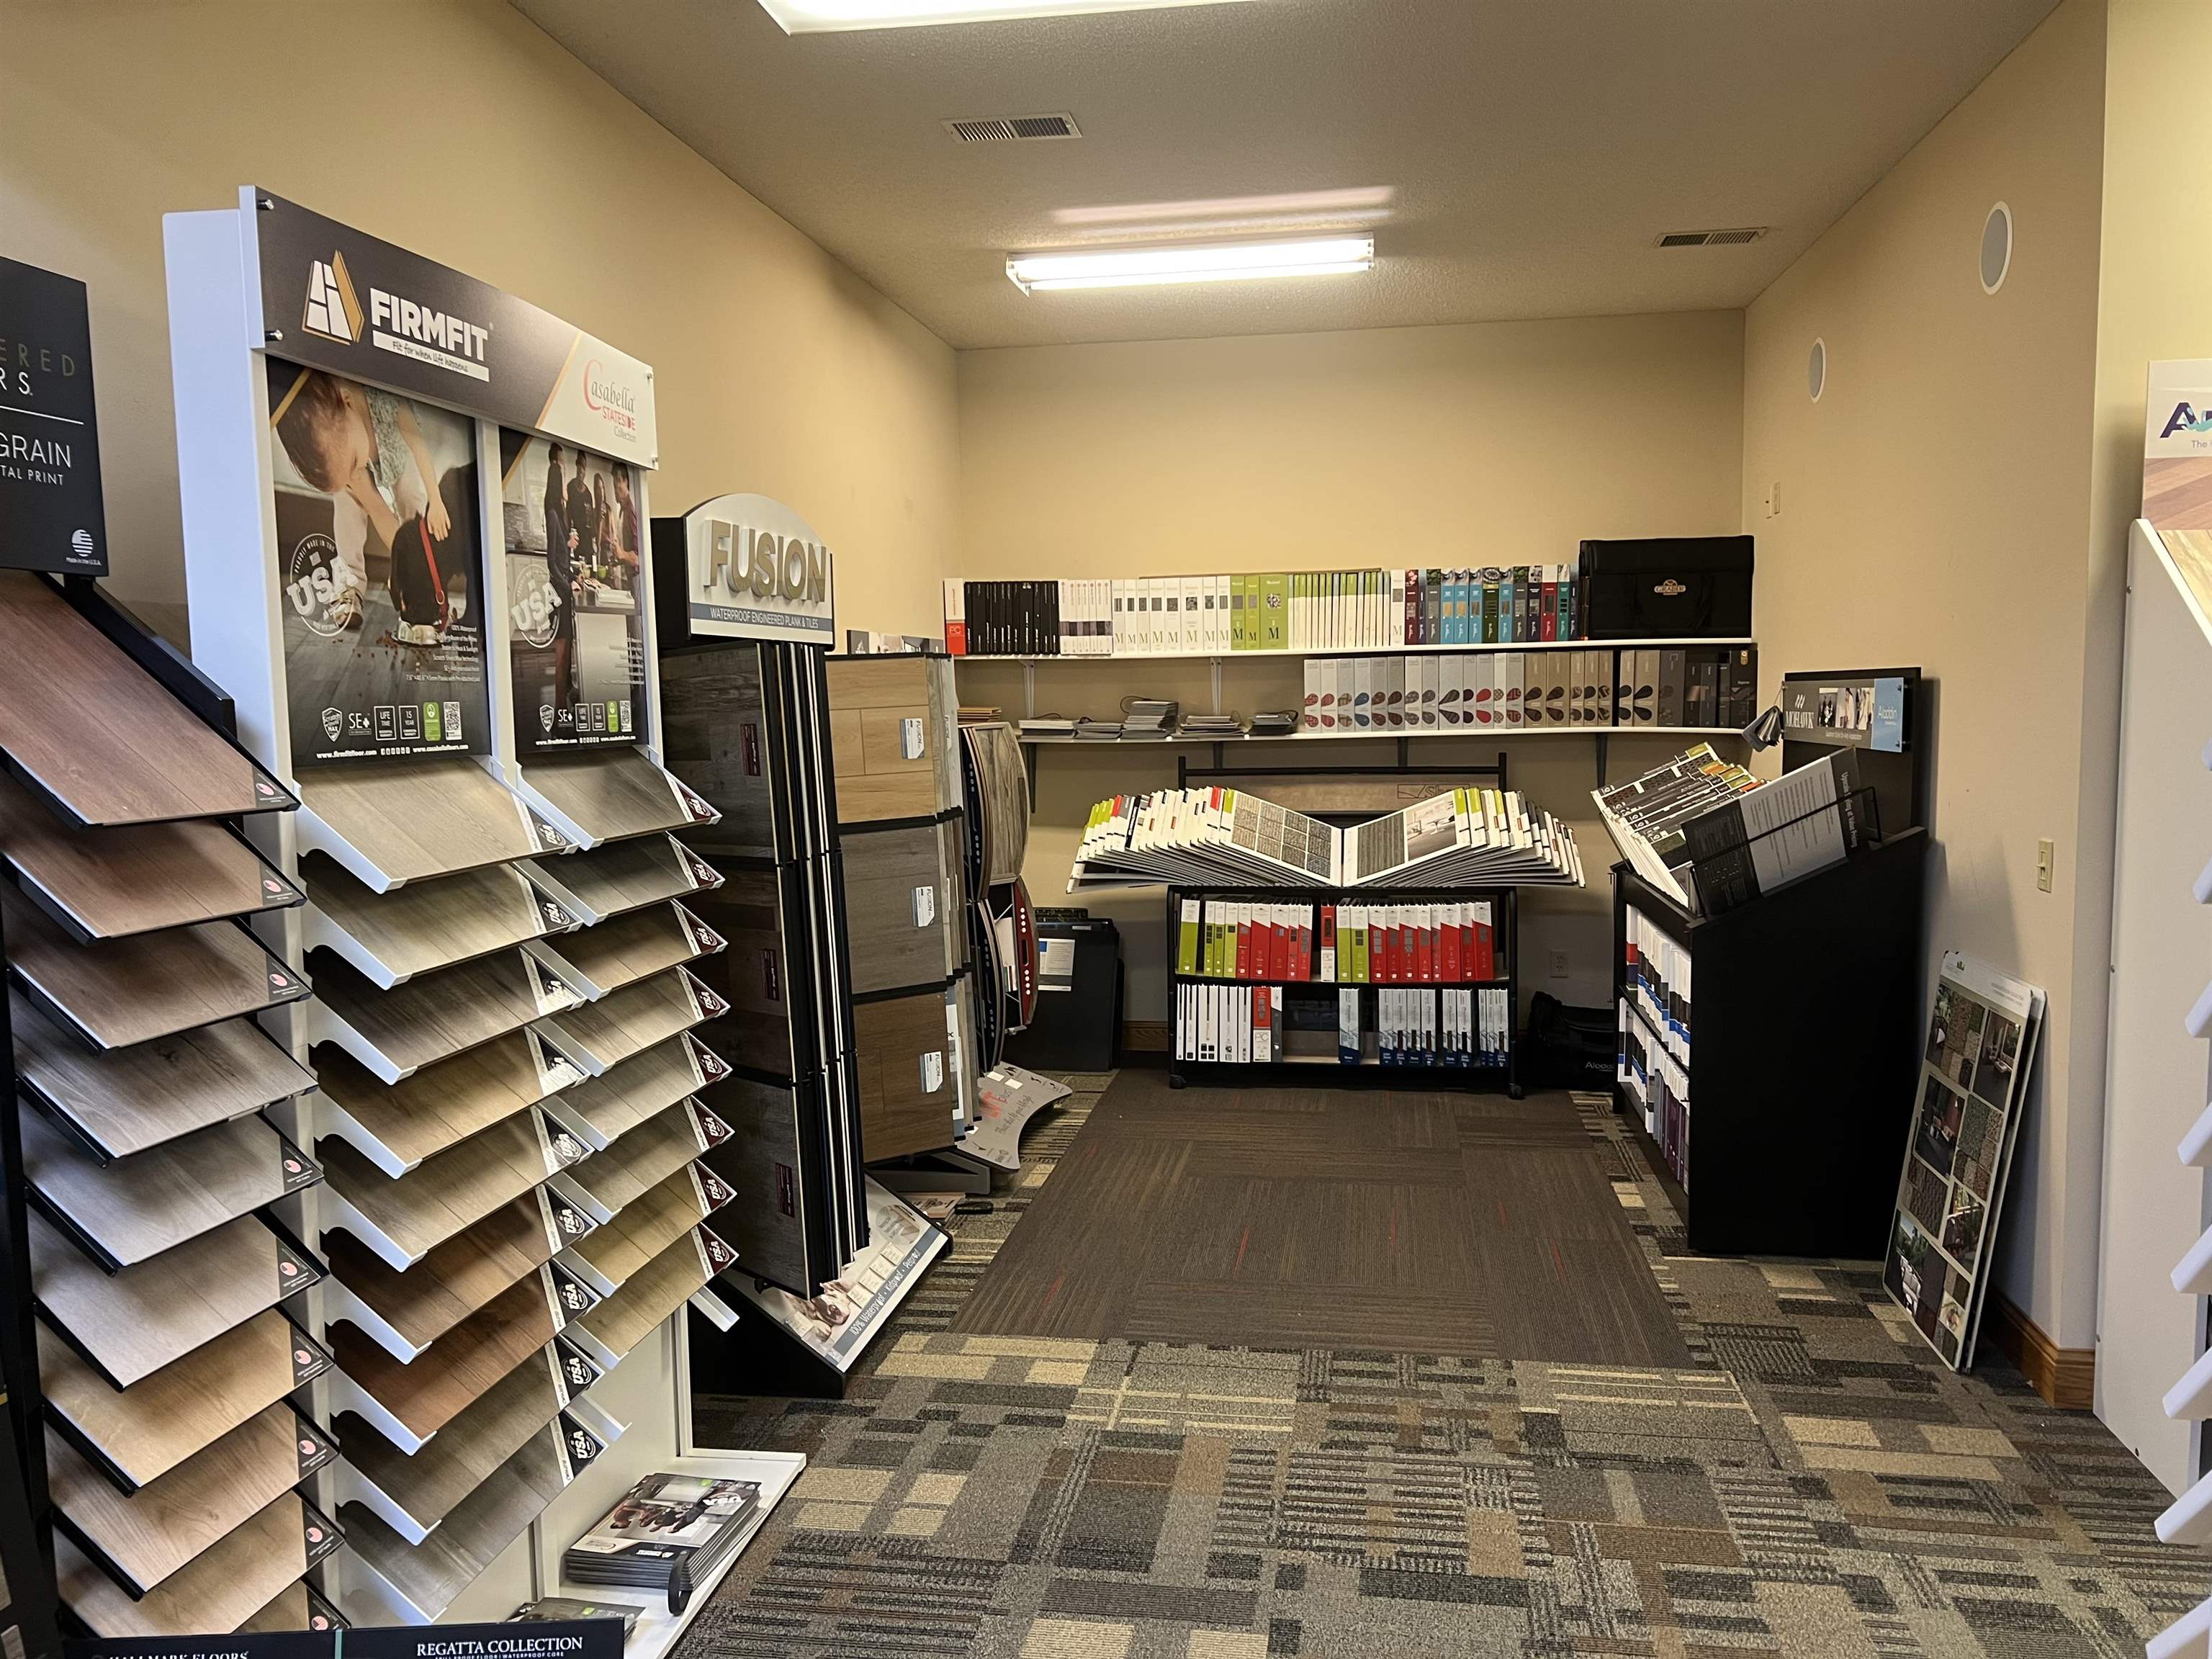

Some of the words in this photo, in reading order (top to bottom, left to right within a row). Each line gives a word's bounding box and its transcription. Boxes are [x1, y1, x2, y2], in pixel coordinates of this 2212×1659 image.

[370, 288, 488, 361] FIRMFIT
[583, 359, 634, 413] Casabella
[602, 406, 636, 431] STATESIDE
[2191, 440, 2208, 449] The
[27, 469, 64, 486] PRINT
[704, 518, 827, 603] FUSION
[511, 582, 562, 631] USA
[710, 607, 751, 622] WATERPROOF
[751, 611, 785, 626] ENGINEERED
[784, 616, 802, 626] PLANK
[806, 617, 819, 629] TILES
[1785, 711, 1814, 729] MOHAWK
[1878, 706, 1897, 720] Aladdin
[691, 799, 706, 816] USA
[542, 824, 558, 844] USA
[695, 864, 709, 880] USA
[547, 902, 562, 924] USA
[698, 927, 711, 945] USA
[701, 992, 714, 1010] USA
[703, 1054, 716, 1074] USA
[705, 1117, 719, 1137] USA
[707, 1179, 721, 1200] USA
[562, 1209, 576, 1233] USA
[711, 1241, 724, 1262] USA
[565, 1284, 580, 1310] USA
[849, 1319, 866, 1336] 100%
[862, 1292, 886, 1325] Waterproof
[884, 1269, 904, 1293] Kidproof
[902, 1247, 922, 1269] Petproof
[569, 1357, 583, 1385] USA
[573, 1430, 588, 1459] USA
[416, 1640, 485, 1656] REGATTA
[487, 1636, 583, 1653] COLLECTION
